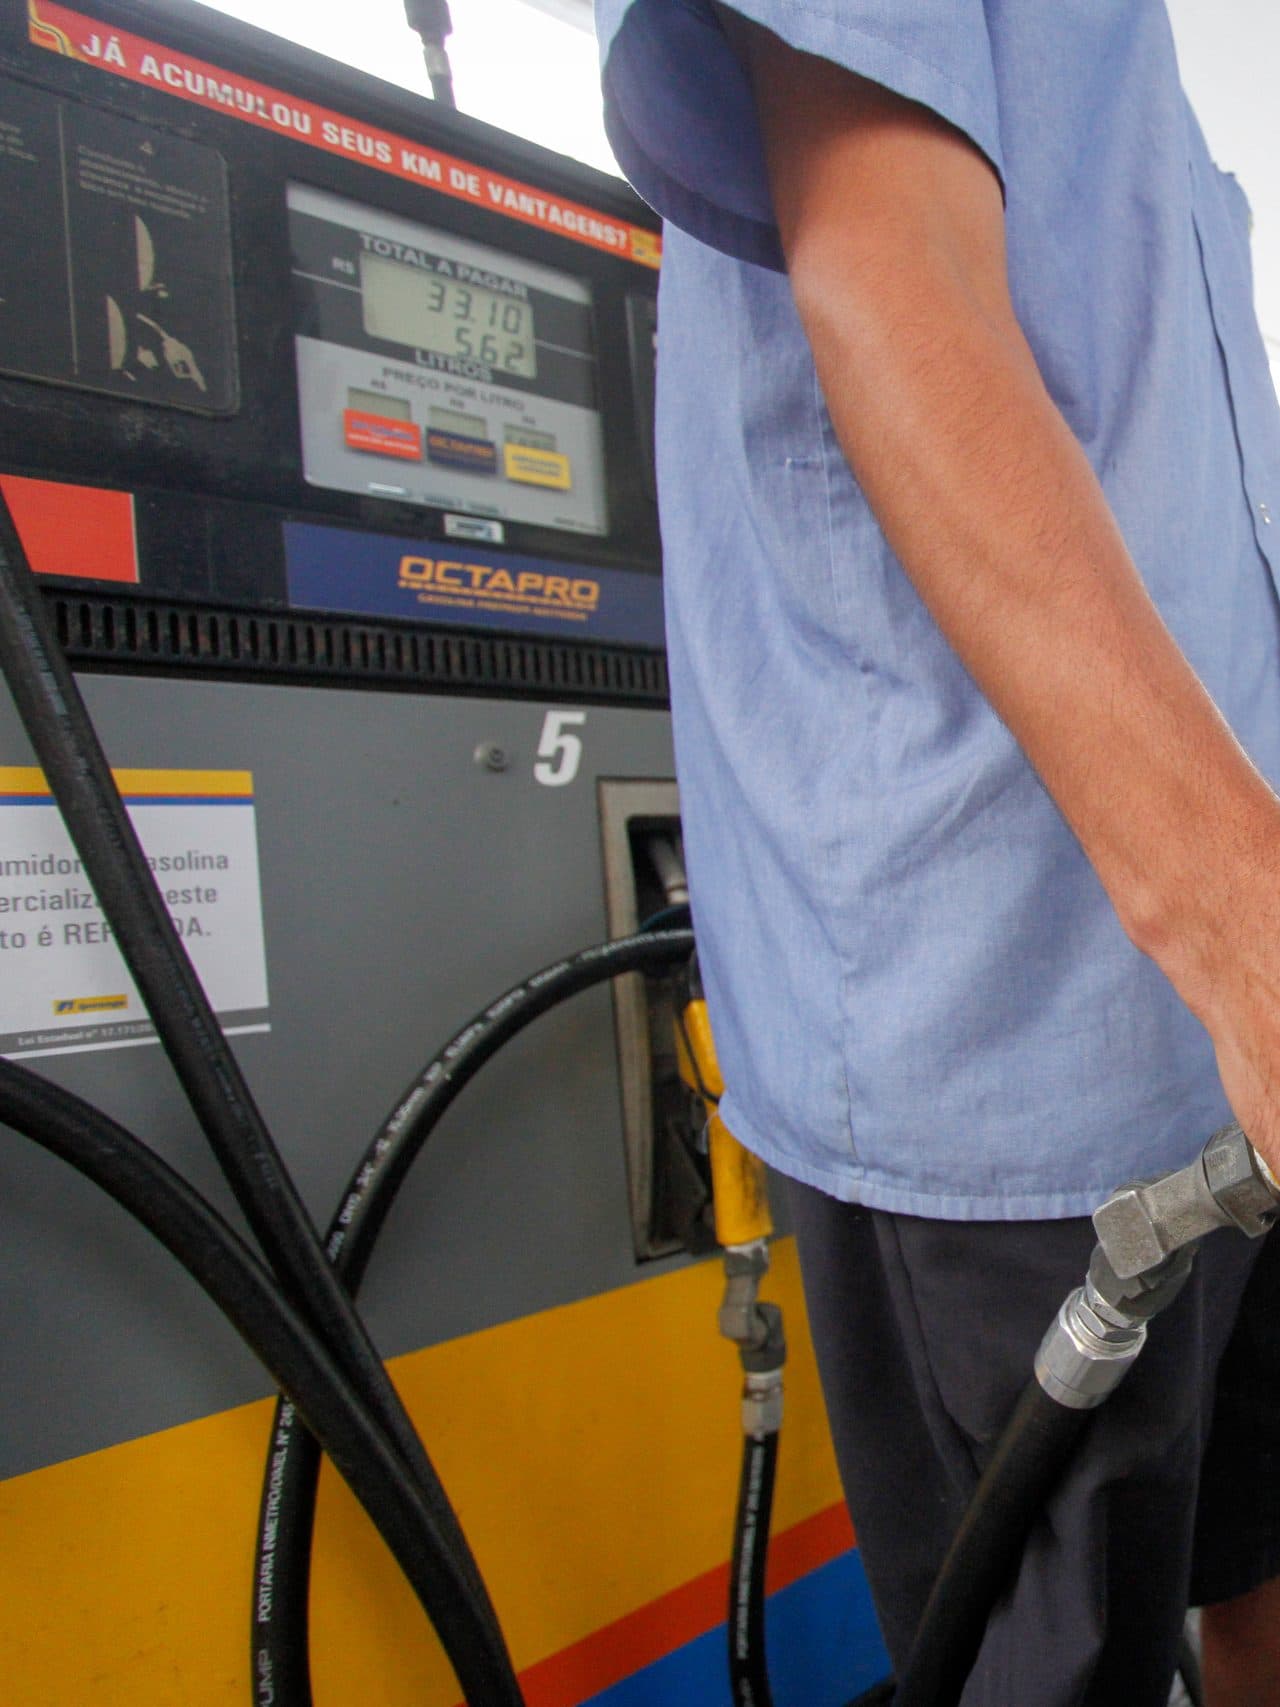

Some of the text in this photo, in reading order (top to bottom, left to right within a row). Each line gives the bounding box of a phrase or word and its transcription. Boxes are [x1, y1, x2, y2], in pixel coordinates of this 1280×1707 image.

[80, 34, 127, 68] JÁ
[139, 54, 312, 135] ACUMULOU
[321, 120, 392, 164] SEUS
[401, 150, 442, 182] KM
[449, 168, 481, 197] DE
[487, 181, 628, 249] VANTAGENS?
[360, 233, 529, 299] TOTAL A PAGAR
[381, 366, 526, 412] PREÇO POR LITRO
[415, 350, 494, 383] LITROS
[398, 555, 600, 604] OCTAPRO
[532, 711, 587, 787] 5
[0, 849, 230, 877] midor asolina
[0, 884, 219, 914] ercializ este
[37, 924, 53, 947] é
[257, 1551, 276, 1623] PORTARIA
